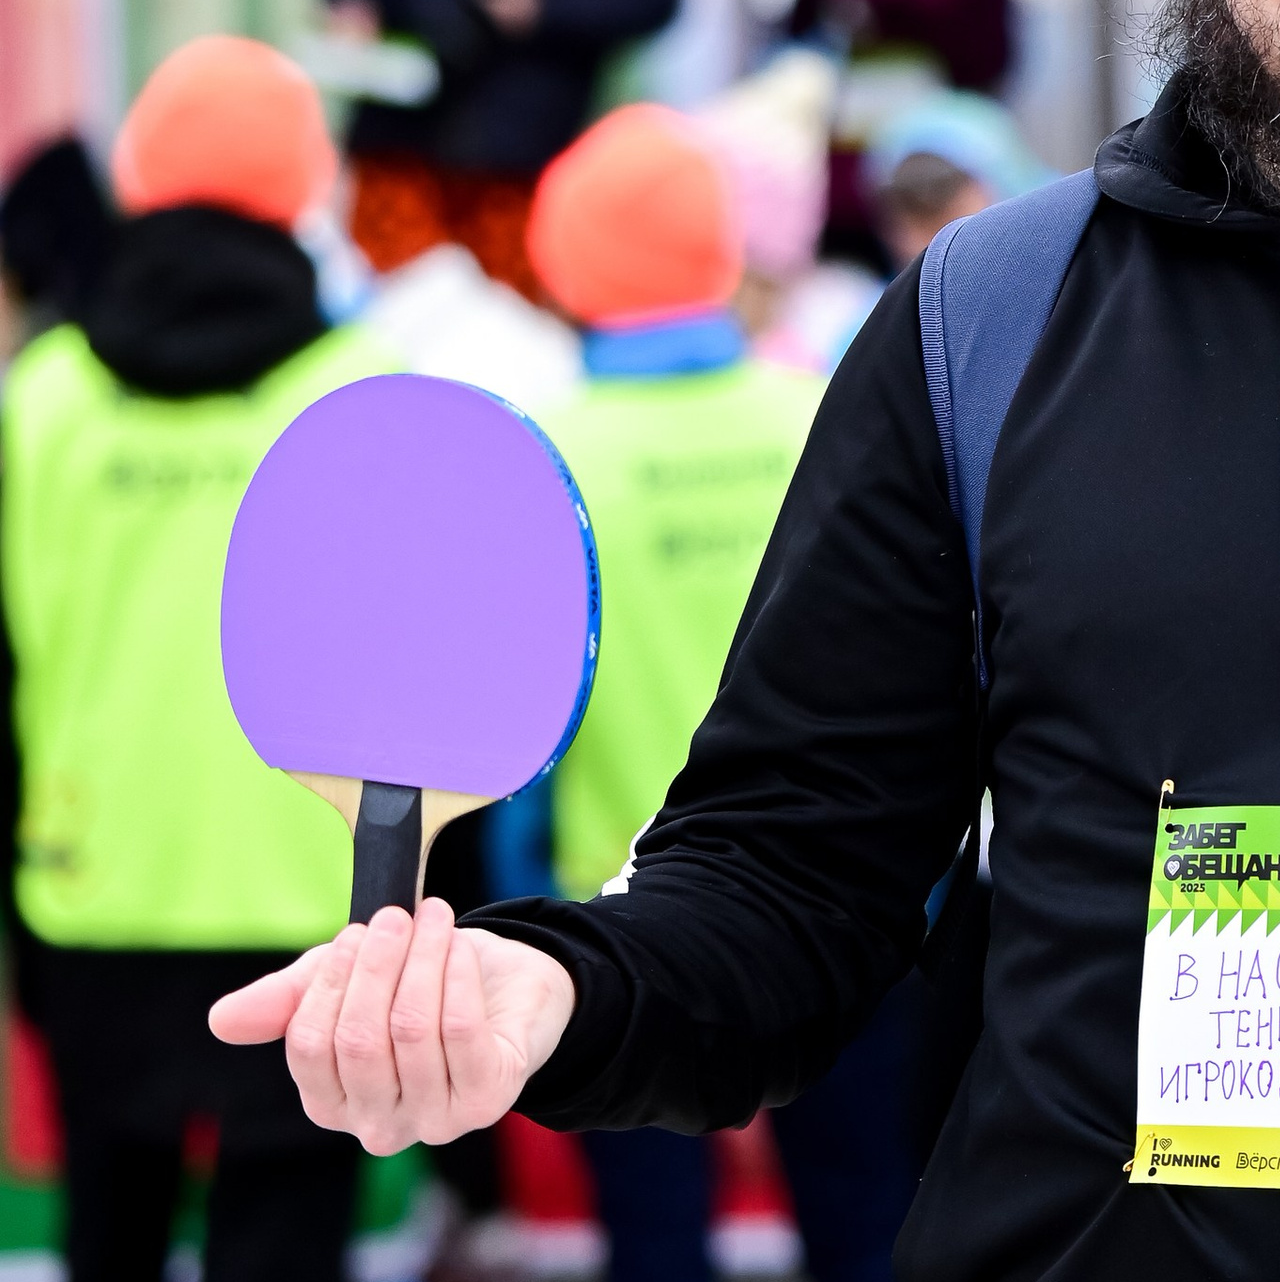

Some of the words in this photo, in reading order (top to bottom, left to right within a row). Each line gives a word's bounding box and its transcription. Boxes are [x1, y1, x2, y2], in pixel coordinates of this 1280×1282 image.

[1167, 822, 1247, 850] ЗАБЕГ
[1180, 883, 1206, 893] 2025
[1169, 953, 1198, 1001] В
[1150, 1153, 1221, 1169] RUNNING
